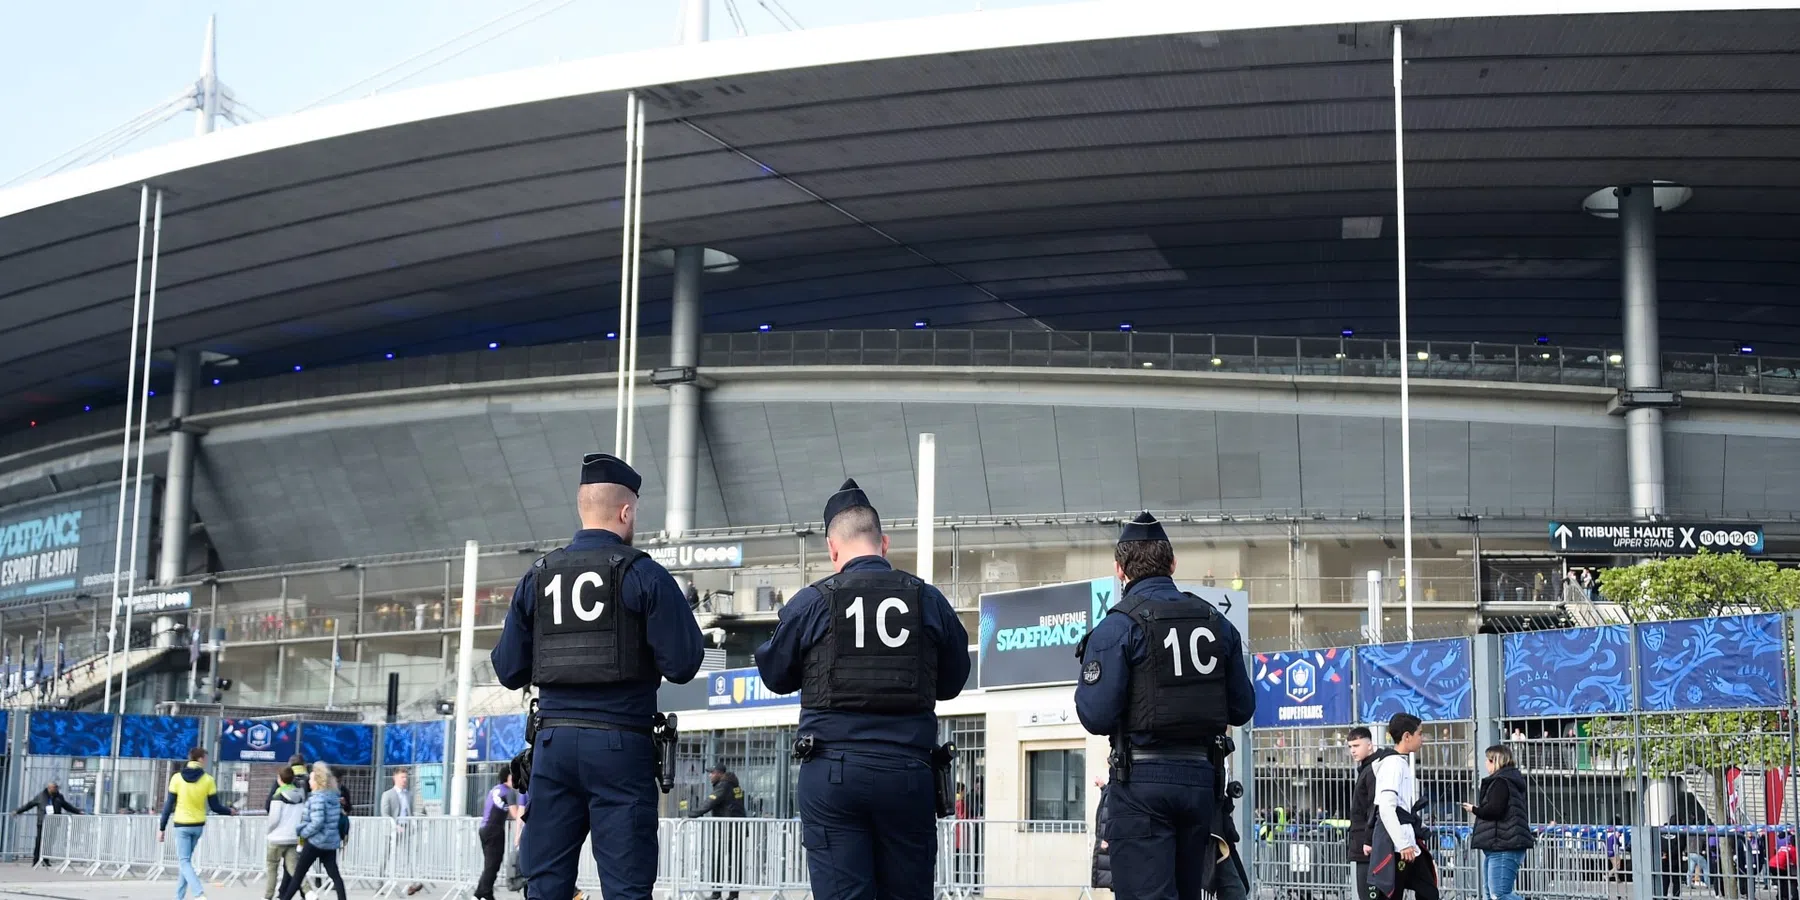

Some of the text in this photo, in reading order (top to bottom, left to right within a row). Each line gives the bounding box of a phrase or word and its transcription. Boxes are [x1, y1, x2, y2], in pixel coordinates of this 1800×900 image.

[0, 510, 82, 558] ADEFRANCE
[1578, 526, 1756, 548] TRIBUNE HAUTE X 10 11 12 13
[1613, 538, 1675, 549] UPPER STAND
[1, 547, 79, 586] ESPORT READY!
[680, 546, 693, 566] U
[544, 571, 605, 625] 1C
[1096, 591, 1110, 620] X
[845, 597, 910, 648] 1C
[1040, 611, 1087, 626] BIENVENUE
[1163, 626, 1218, 677] 1C
